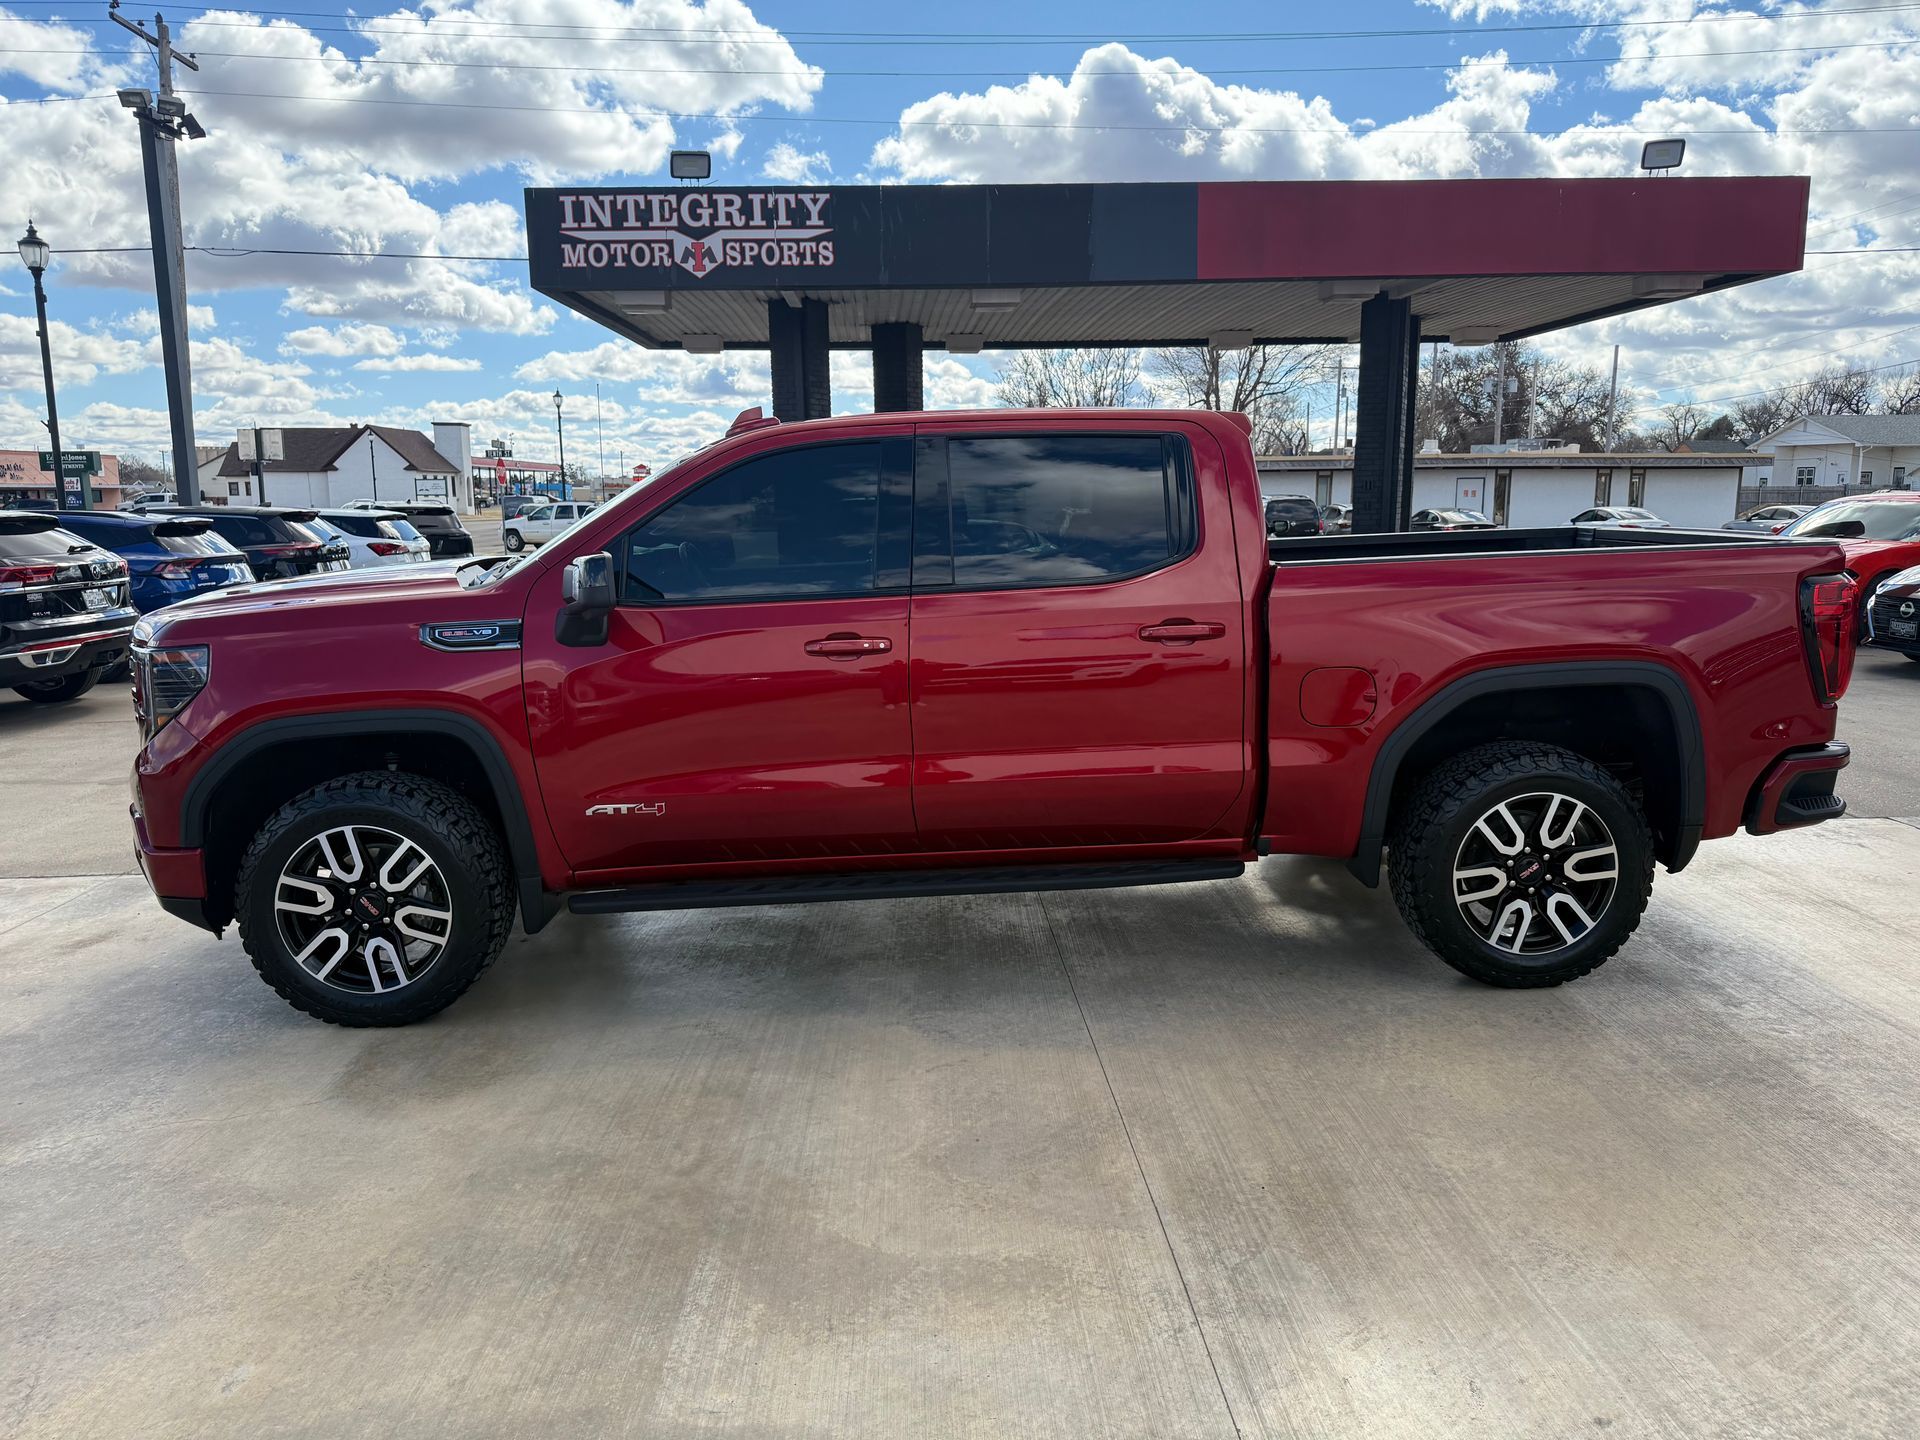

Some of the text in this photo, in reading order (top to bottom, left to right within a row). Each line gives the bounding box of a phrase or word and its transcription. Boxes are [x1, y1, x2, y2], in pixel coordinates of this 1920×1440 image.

[558, 193, 831, 229] INTEGRITY
[560, 240, 835, 268] MOTOR SPORTS
[585, 802, 666, 817] AT4
